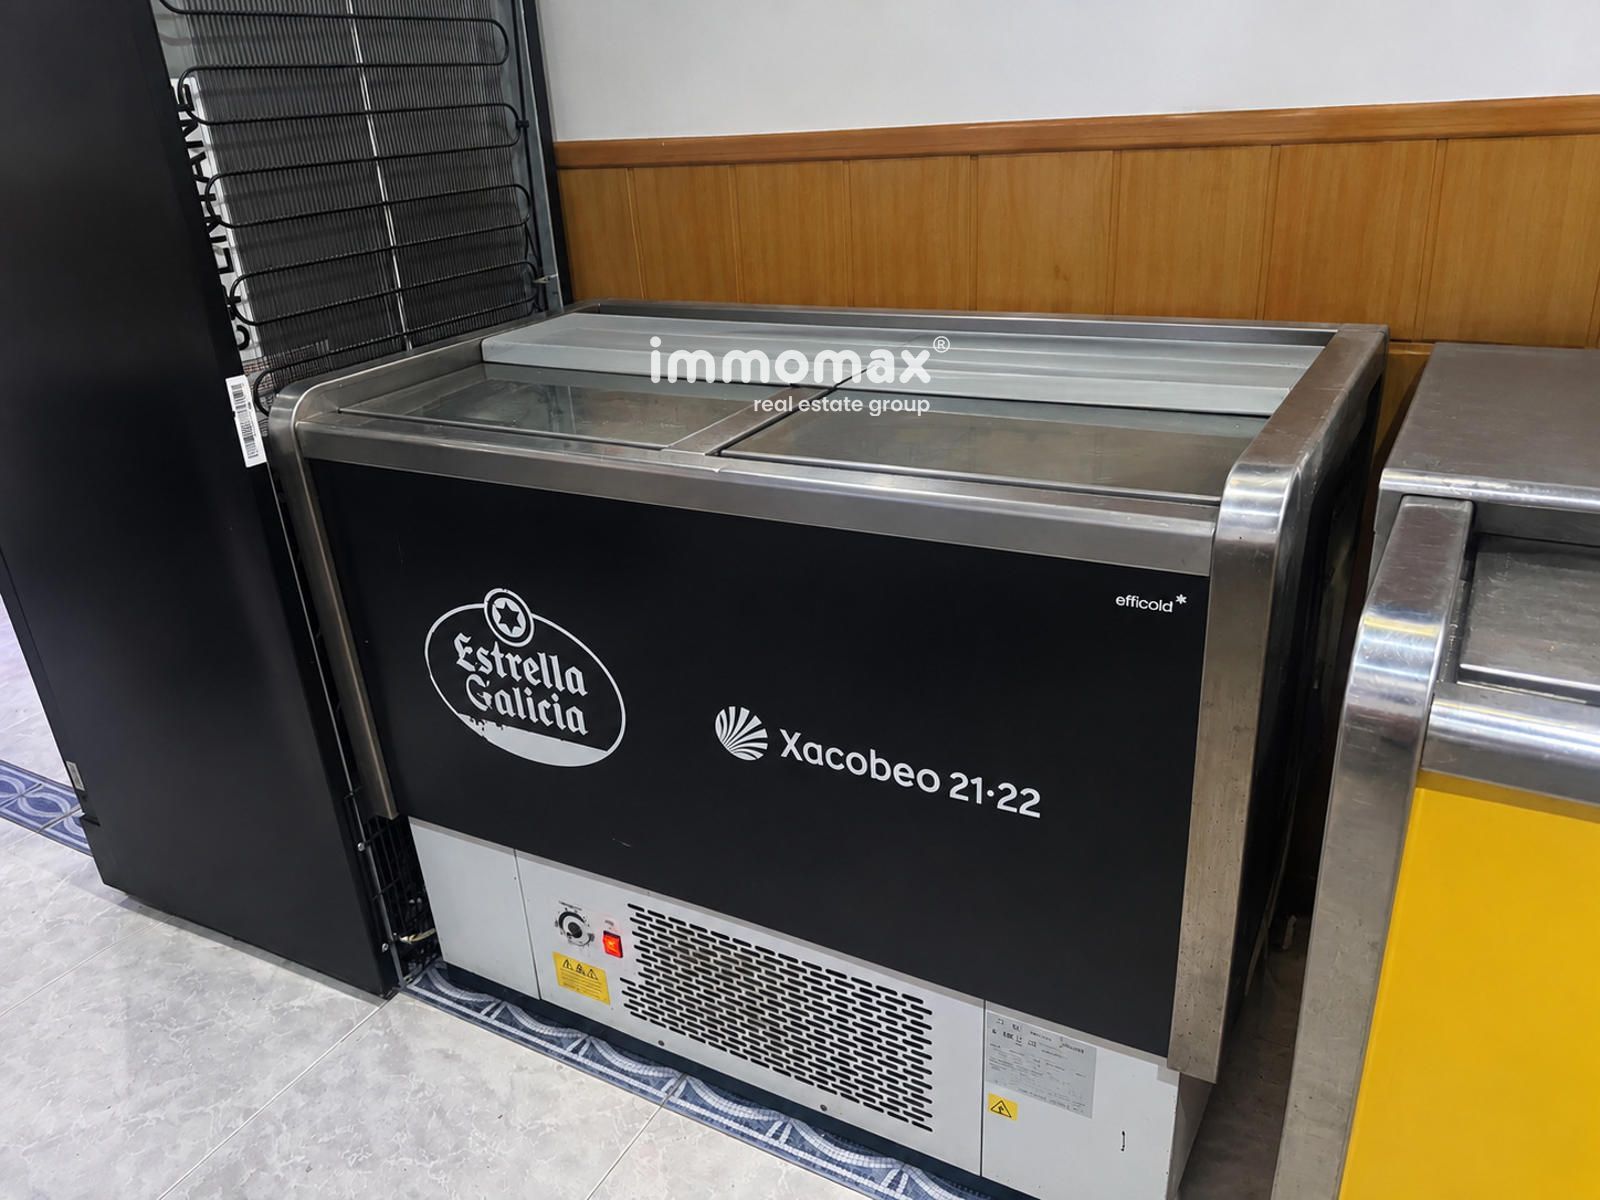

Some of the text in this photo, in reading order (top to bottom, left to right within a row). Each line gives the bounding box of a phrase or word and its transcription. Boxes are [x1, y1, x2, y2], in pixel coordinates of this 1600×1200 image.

[453, 633, 588, 696] Estrella
[466, 674, 588, 735] Galicia
[779, 728, 941, 793] Xacobeo
